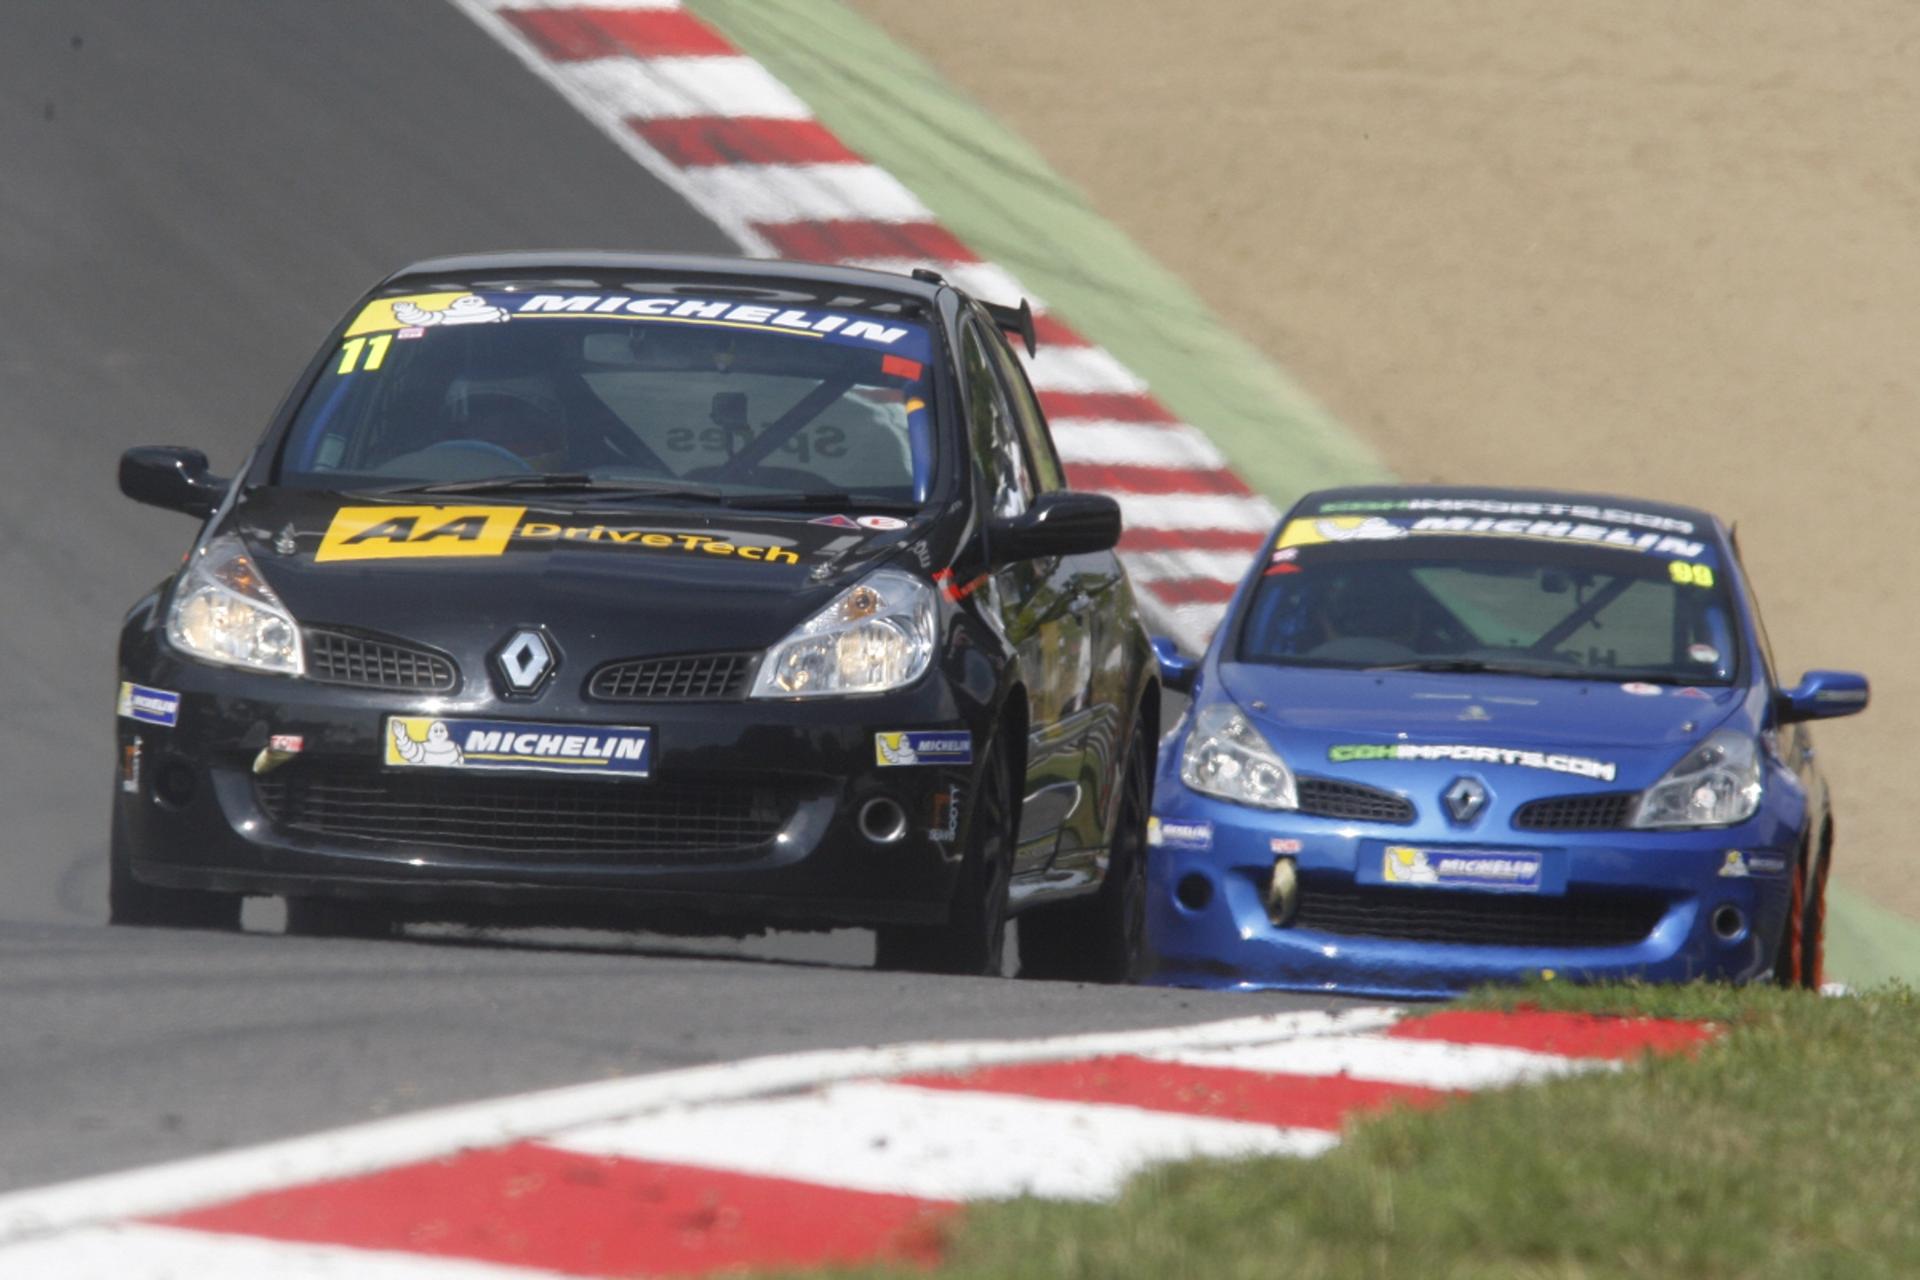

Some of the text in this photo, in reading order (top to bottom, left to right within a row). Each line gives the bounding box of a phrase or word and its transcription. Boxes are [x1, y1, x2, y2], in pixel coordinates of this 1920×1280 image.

[519, 294, 906, 344] MICHELIN
[337, 334, 393, 375] 11
[339, 516, 800, 566] AA DriveTech
[1411, 517, 1704, 557] MICHELIN
[464, 730, 646, 760] MICHELIN
[917, 740, 970, 752] MICHELIN
[1438, 858, 1539, 879] MICHELIN
